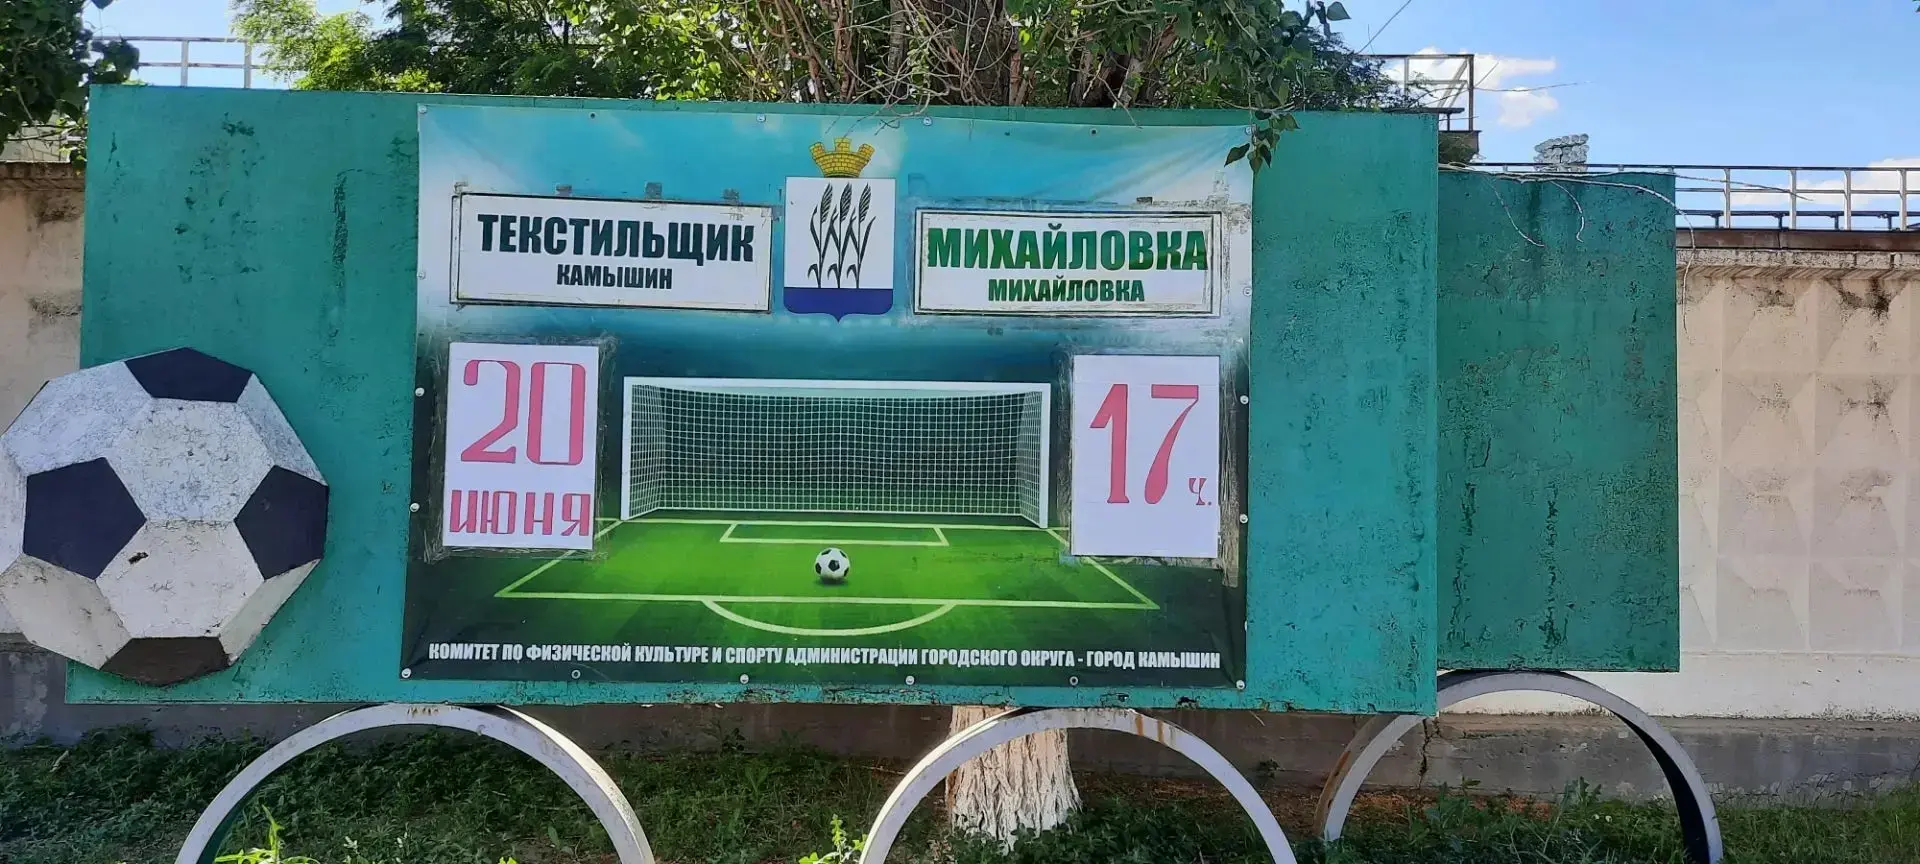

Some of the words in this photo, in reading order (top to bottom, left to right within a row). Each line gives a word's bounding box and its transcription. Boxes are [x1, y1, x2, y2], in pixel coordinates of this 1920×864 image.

[477, 214, 755, 267] ТЕКСТИЛЬЩИК
[927, 222, 1209, 271] МИХАЙЛОВКА
[556, 264, 673, 290] КАМЫШИН
[988, 275, 1145, 302] МИХАЙЛОВКА
[461, 359, 586, 465] 20
[1089, 384, 1200, 505] 17
[449, 489, 591, 537] ИЮНЯ
[428, 643, 500, 660] КОМИТЕТ
[502, 644, 523, 661] ПО
[526, 642, 632, 662] ФИЗИЧЕСКОЙ
[635, 646, 709, 663] КУЛЬТУРЕ
[711, 647, 722, 664] И
[725, 646, 783, 664] СПОРТУ
[784, 647, 918, 666] АДМИНИСТРАЦИИ
[921, 648, 1018, 667] ГОРОДСКОГО
[1020, 650, 1076, 667] ОКРУГА
[1086, 650, 1136, 670] ГОРОД
[1138, 651, 1221, 669] КАМЫШИН
